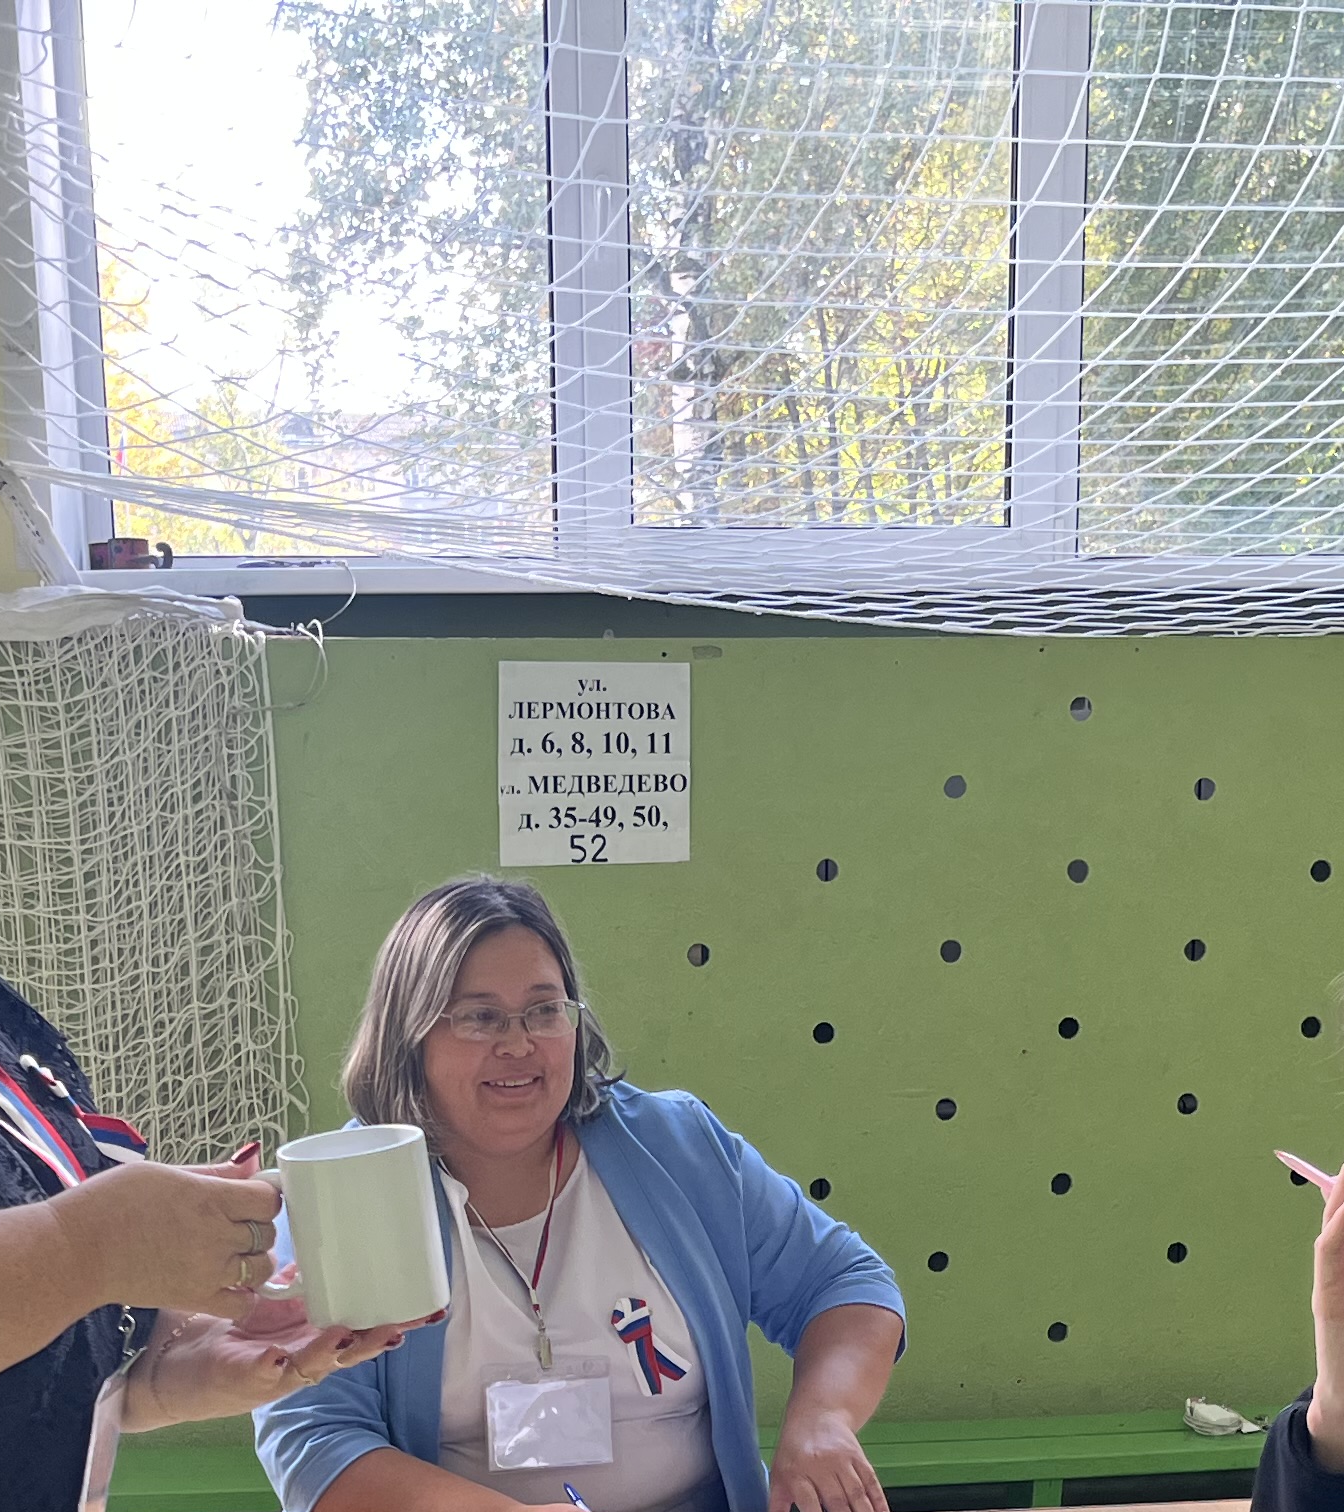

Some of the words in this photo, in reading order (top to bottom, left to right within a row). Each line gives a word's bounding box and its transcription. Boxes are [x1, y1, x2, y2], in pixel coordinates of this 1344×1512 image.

[577, 679, 607, 697] ул.
[508, 701, 676, 721] ЛЕРМОНТОВА
[509, 737, 533, 757] д.
[541, 731, 563, 758] 6,
[571, 731, 593, 759] 8,
[603, 731, 638, 759] 10,
[647, 731, 671, 754] 11
[527, 773, 688, 797] МЕДВЕДЕВО
[517, 813, 540, 832] д.
[548, 805, 625, 833] 35-49,
[632, 804, 669, 832] 50,
[569, 833, 609, 864] 52
